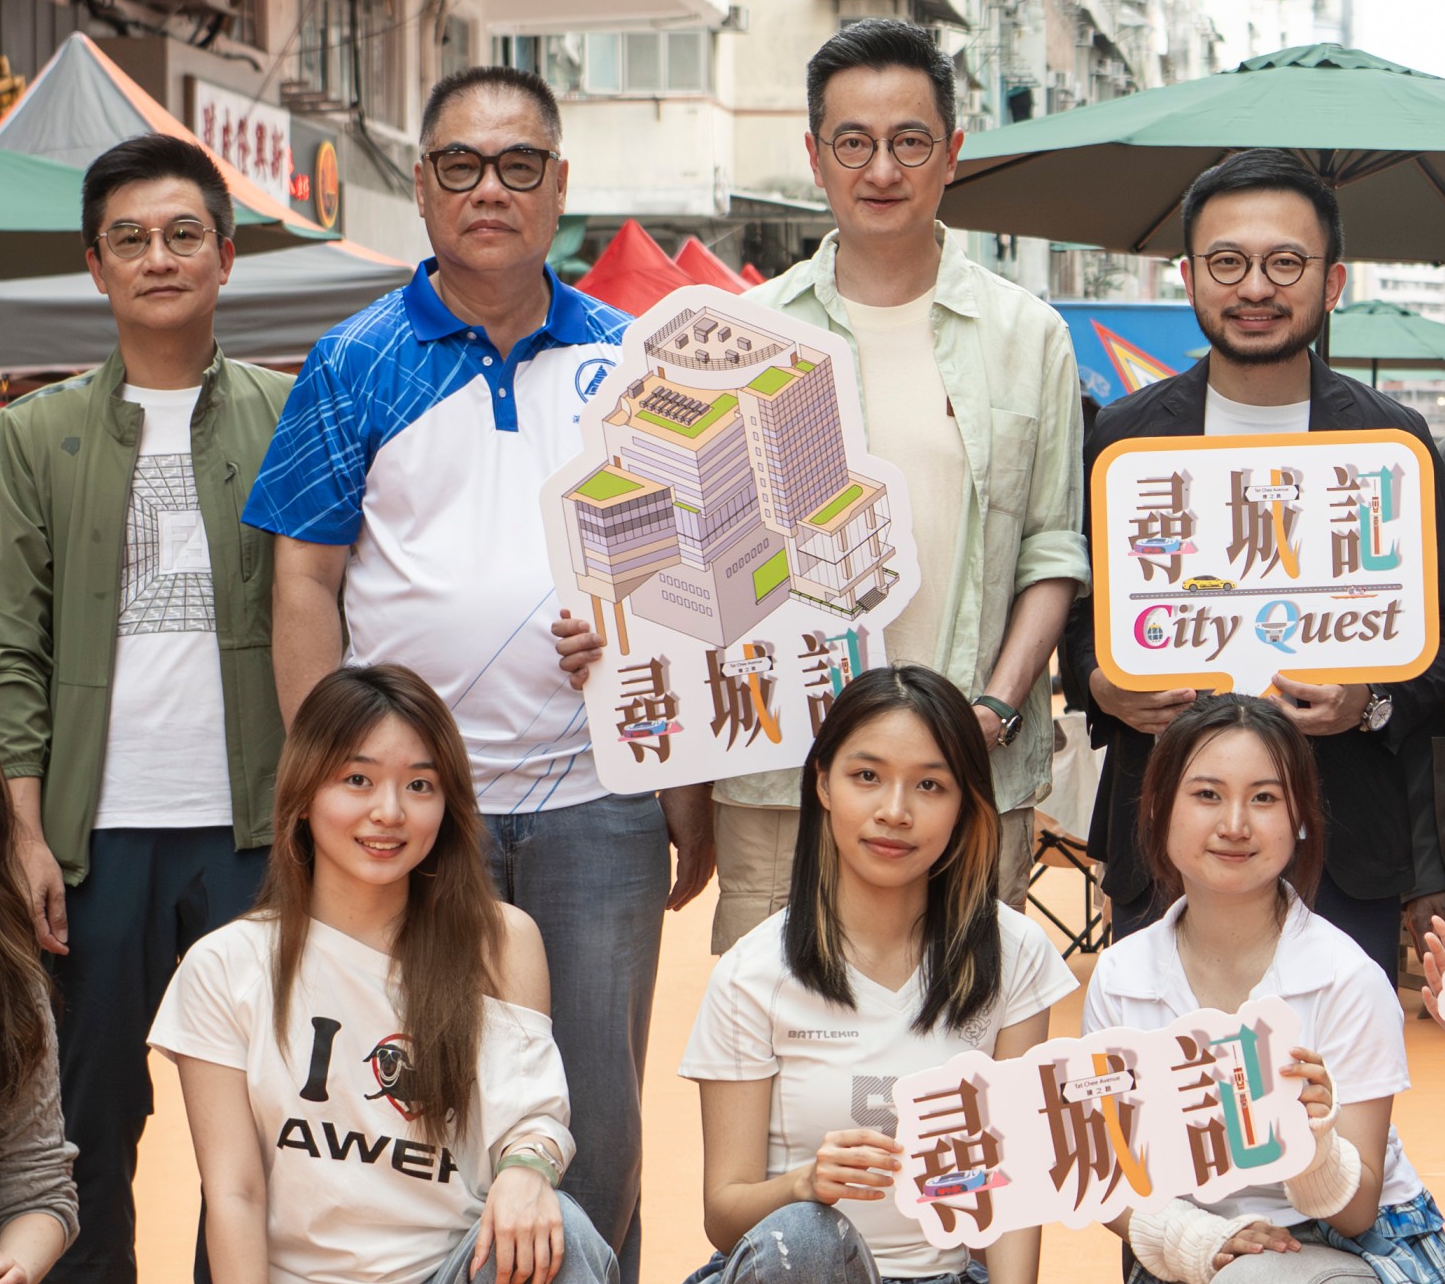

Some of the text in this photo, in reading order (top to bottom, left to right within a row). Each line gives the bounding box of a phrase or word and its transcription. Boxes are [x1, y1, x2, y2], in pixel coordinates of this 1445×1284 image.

[1127, 464, 1401, 585] 尋城記
[1133, 599, 1402, 662] City Quest
[298, 1015, 343, 1103] I
[788, 1030, 859, 1039] BATTLEKID
[911, 1023, 1287, 1233] 尋城記
